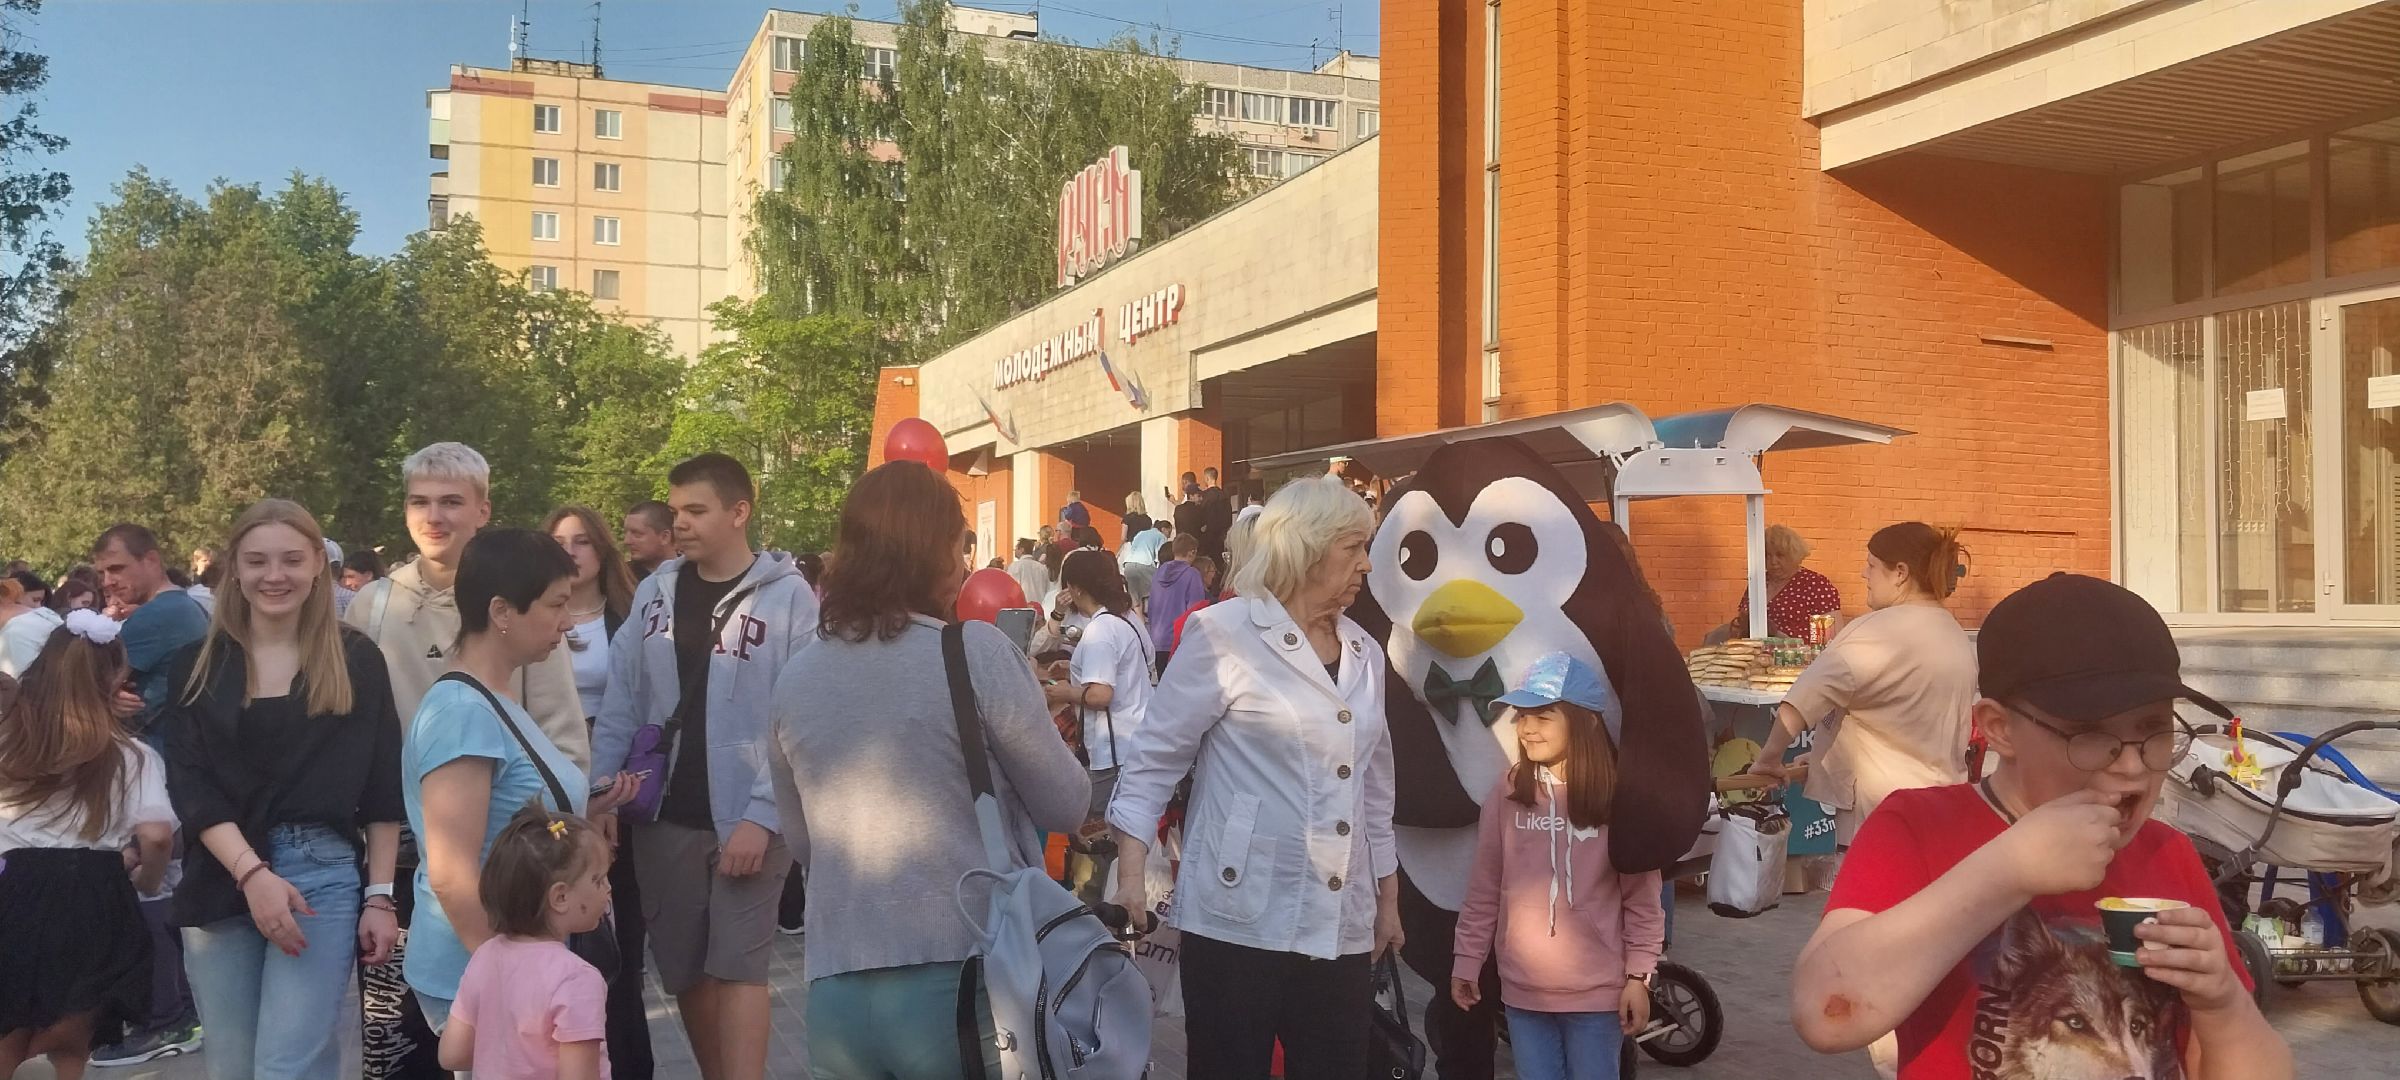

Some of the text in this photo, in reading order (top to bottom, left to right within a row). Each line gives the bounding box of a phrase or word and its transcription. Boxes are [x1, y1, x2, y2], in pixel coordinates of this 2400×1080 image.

[1058, 145, 1140, 288] РУСЬ
[993, 284, 1184, 389] МОЛОДЕЖНЫЙ ЦЕНТР
[641, 598, 766, 662] GP
[1515, 811, 1565, 831] Likee
[1970, 983, 2012, 1080] BORN
